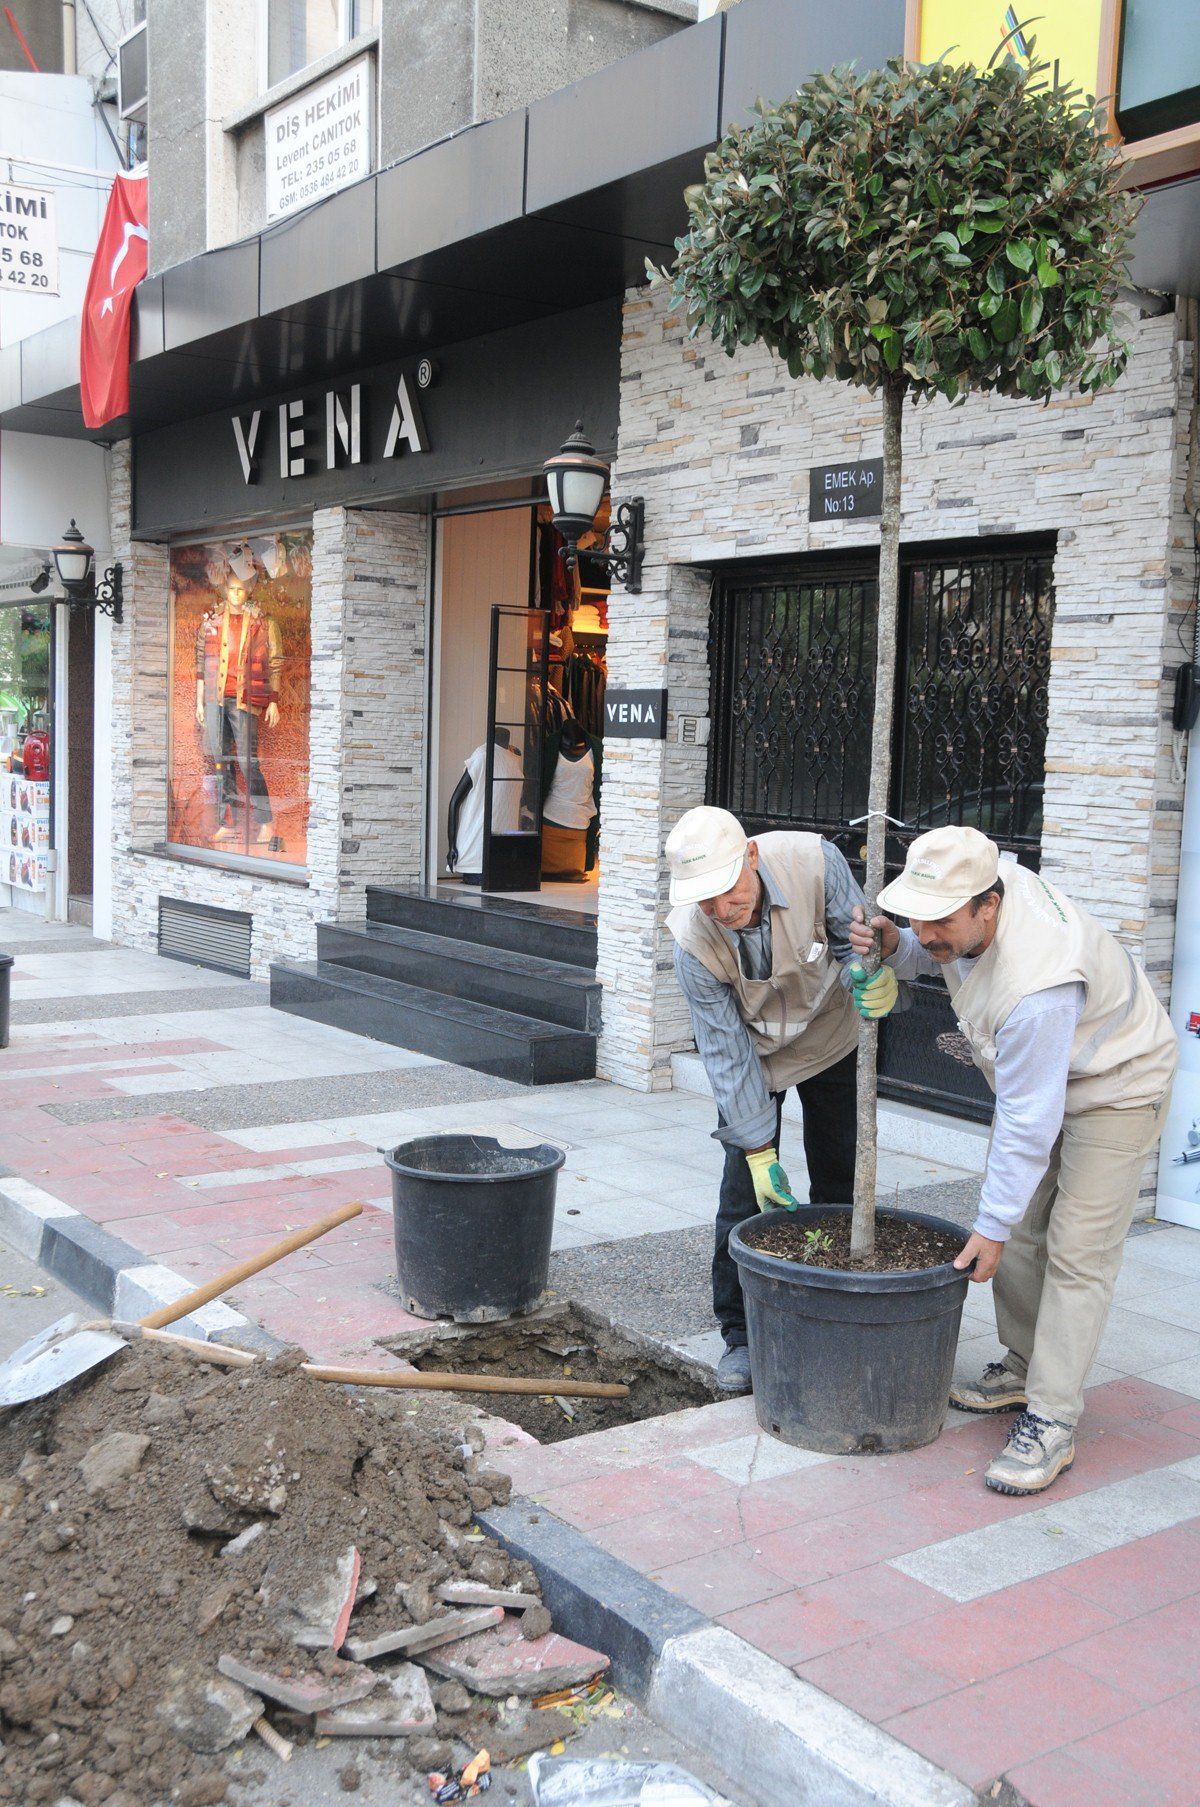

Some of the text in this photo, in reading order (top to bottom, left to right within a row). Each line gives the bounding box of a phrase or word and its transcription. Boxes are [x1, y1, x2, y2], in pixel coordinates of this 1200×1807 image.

[276, 74, 361, 140] DİŞ HEKİMİ
[276, 110, 362, 171] Levent CANITOK
[281, 139, 357, 190] TEL: 235 05 68
[299, 179, 318, 199] 0536
[320, 172, 335, 188] 484
[336, 164, 347, 180] 42
[348, 158, 359, 174] 20
[20, 250, 44, 268] 68
[8, 270, 26, 285] 42
[31, 273, 49, 288] 20
[231, 373, 422, 485] VENA
[825, 469, 876, 490] EMEK Ap.
[825, 494, 855, 514] No:13
[606, 703, 656, 723] VENA
